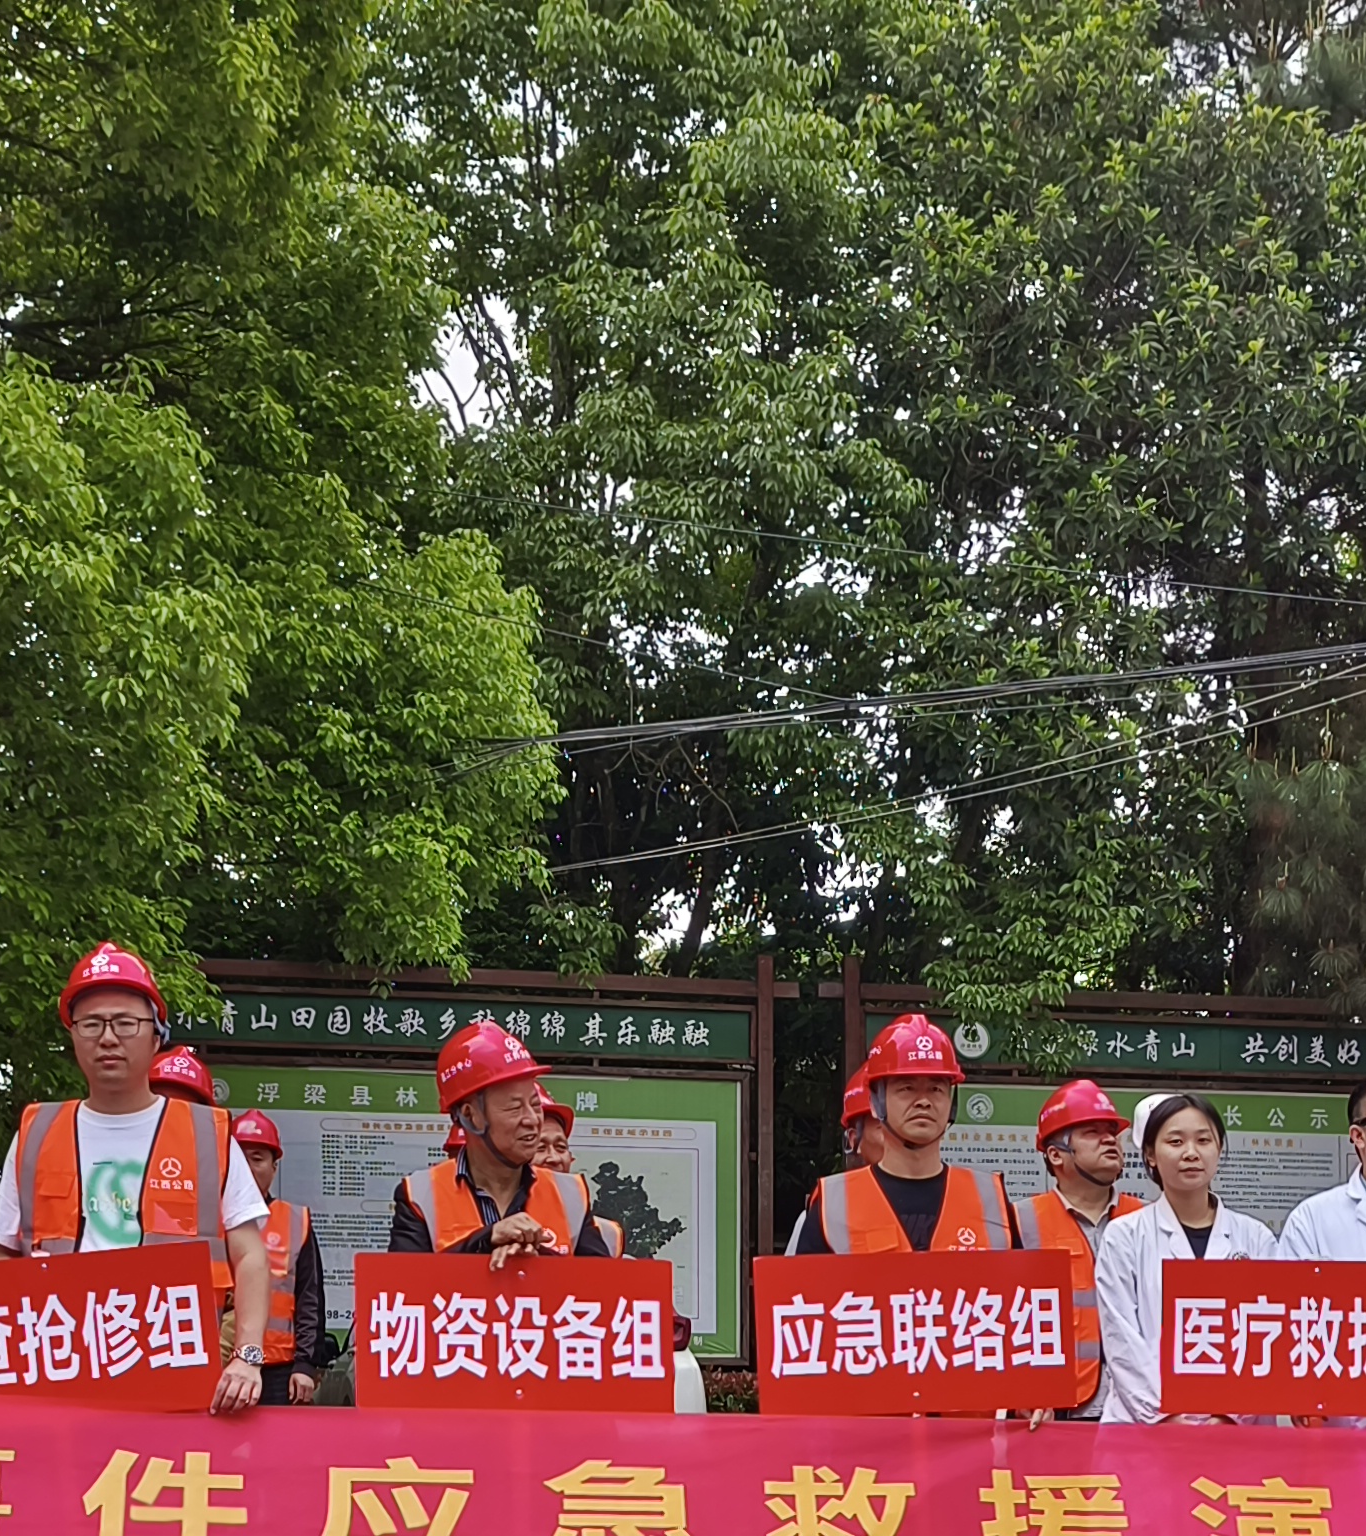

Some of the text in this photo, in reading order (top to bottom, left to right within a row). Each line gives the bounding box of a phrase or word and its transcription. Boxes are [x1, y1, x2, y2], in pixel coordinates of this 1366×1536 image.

[1011, 1024, 1195, 1063] 绿水青山
[369, 1292, 666, 1380] 物资设备组
[771, 1285, 1066, 1379] 应急联络组
